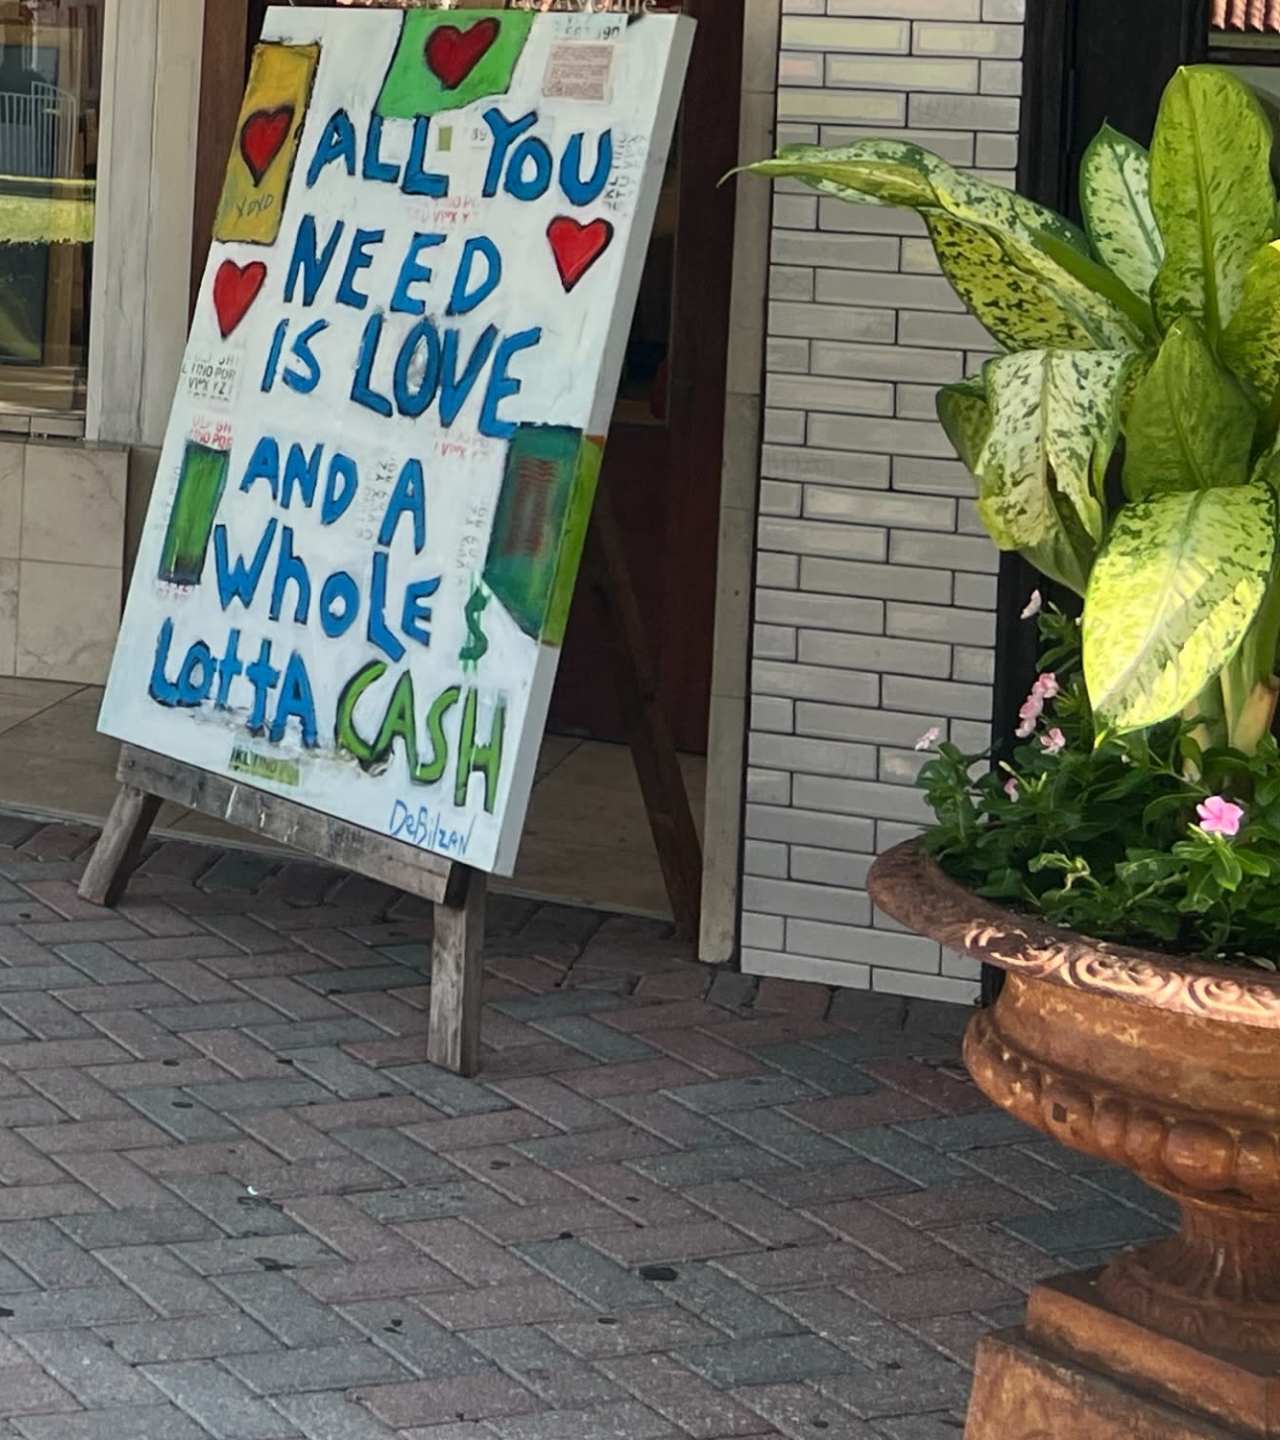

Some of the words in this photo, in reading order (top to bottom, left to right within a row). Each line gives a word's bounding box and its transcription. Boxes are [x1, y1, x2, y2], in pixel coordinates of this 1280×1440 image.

[306, 108, 449, 197] ALL
[482, 107, 613, 206] YOU
[283, 214, 503, 317] NEED
[260, 317, 330, 394] IS
[349, 312, 543, 439] LOVE
[239, 435, 359, 526] AND
[377, 457, 427, 555] A
[336, 658, 508, 816] CASH
